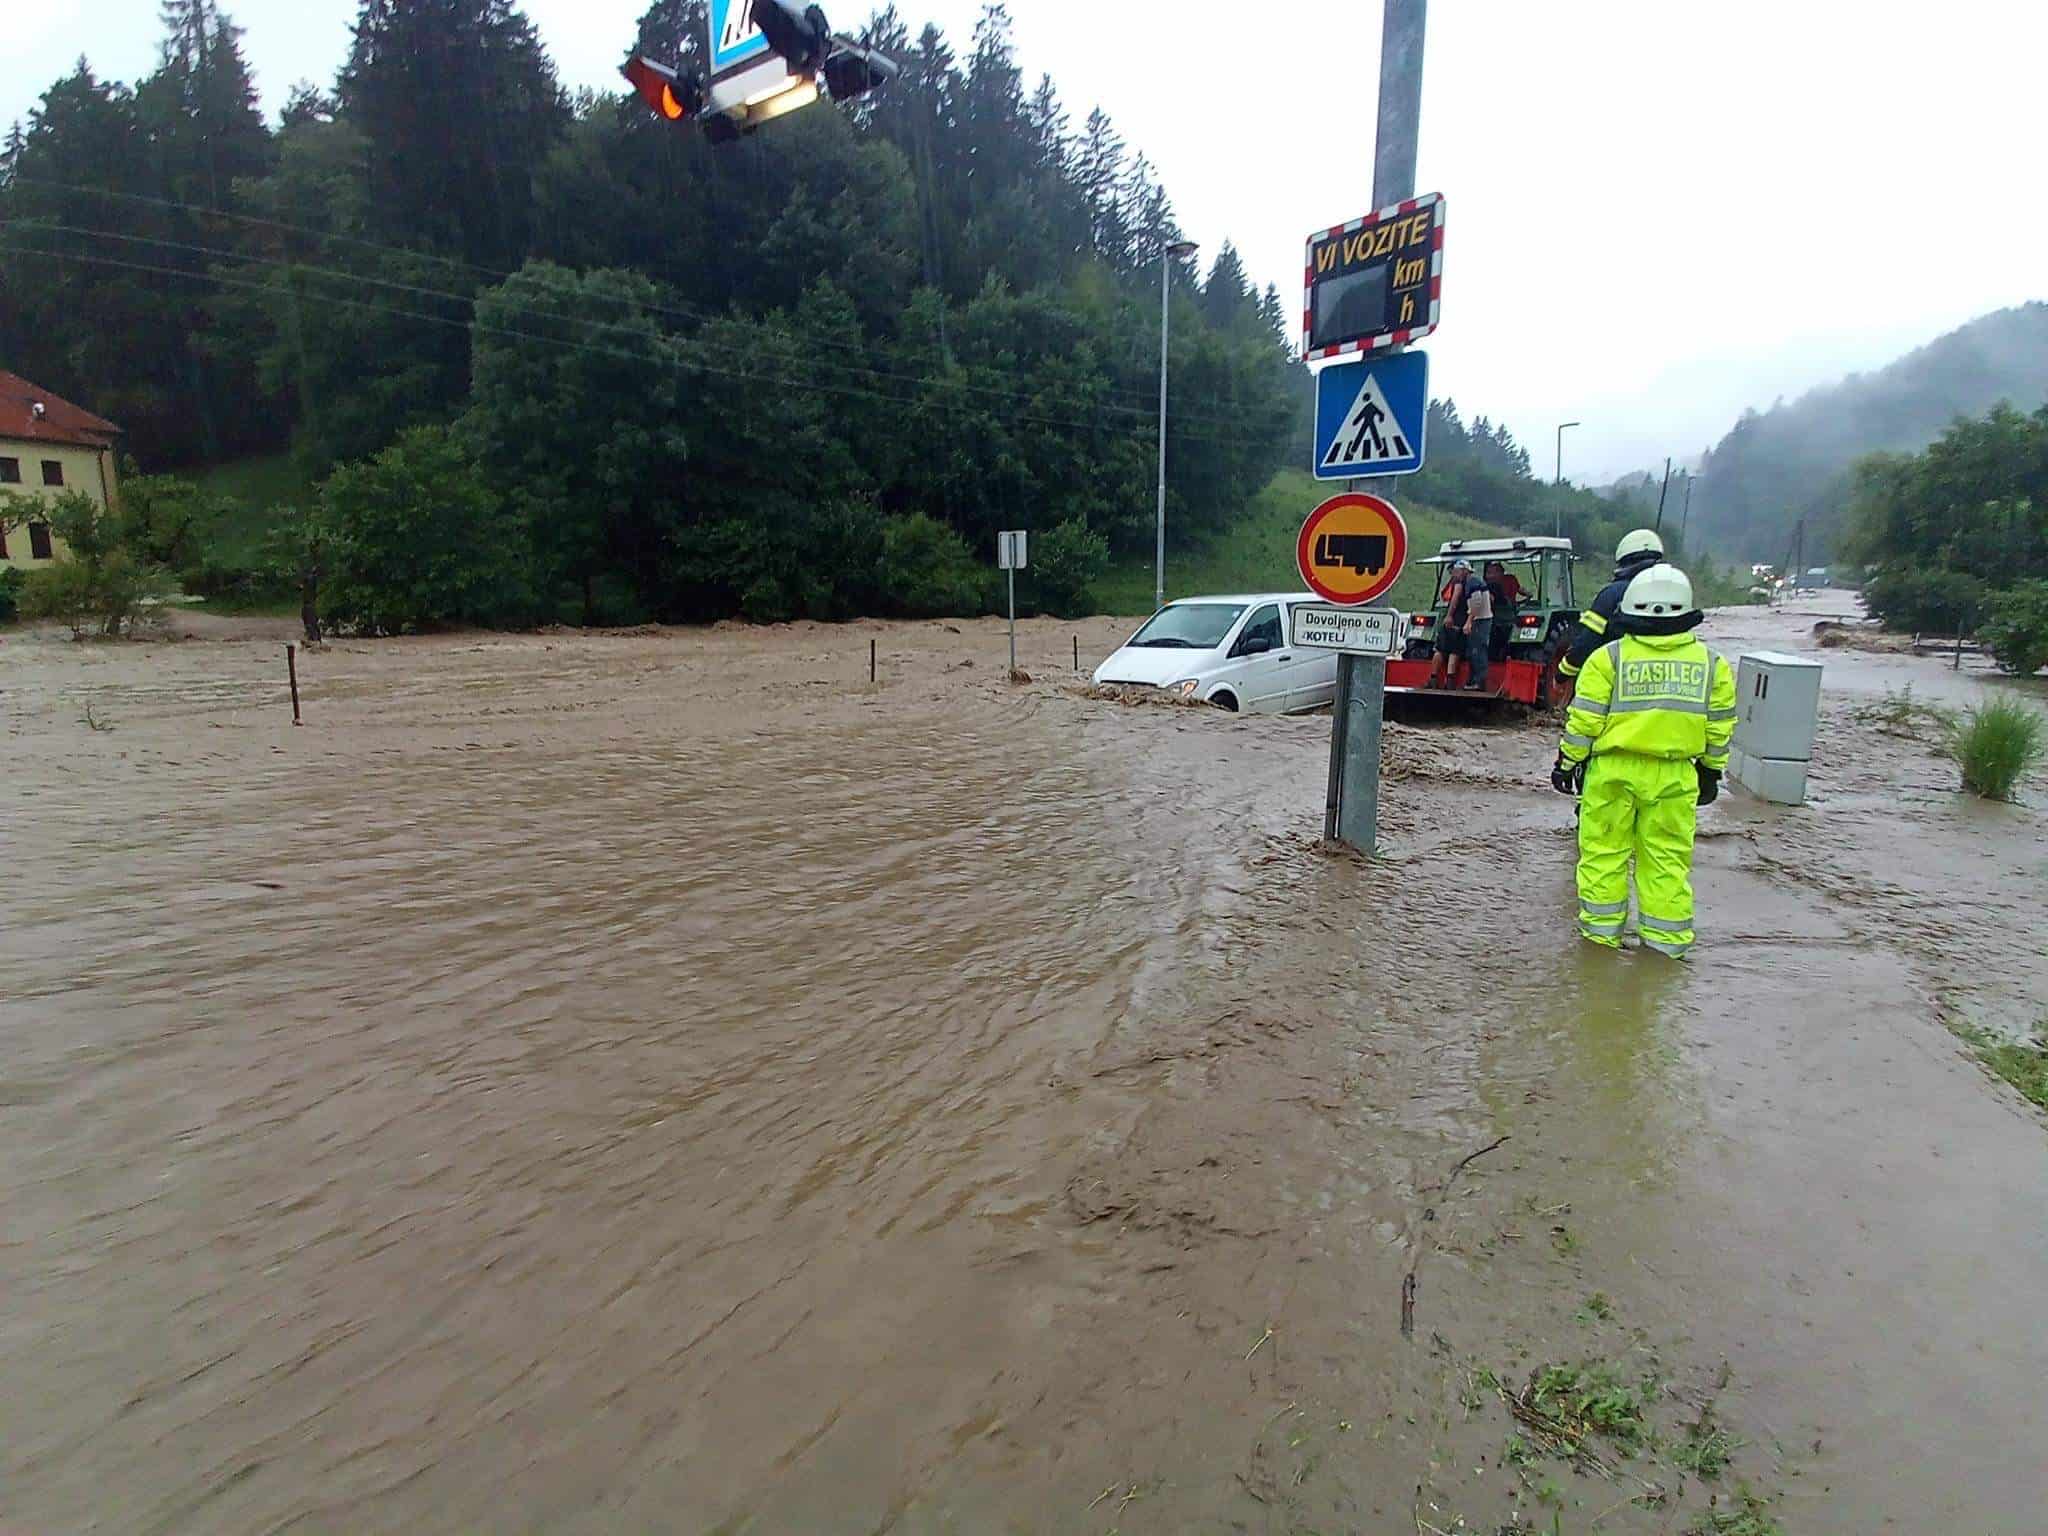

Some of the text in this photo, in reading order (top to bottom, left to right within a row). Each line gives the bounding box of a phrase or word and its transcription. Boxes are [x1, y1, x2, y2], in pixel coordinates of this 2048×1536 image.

[1316, 212, 1430, 272] VI VOZITE
[1393, 257, 1426, 287] km
[1400, 293, 1414, 323] h
[1366, 616, 1380, 629] do
[1627, 662, 1702, 684] GASILEC
